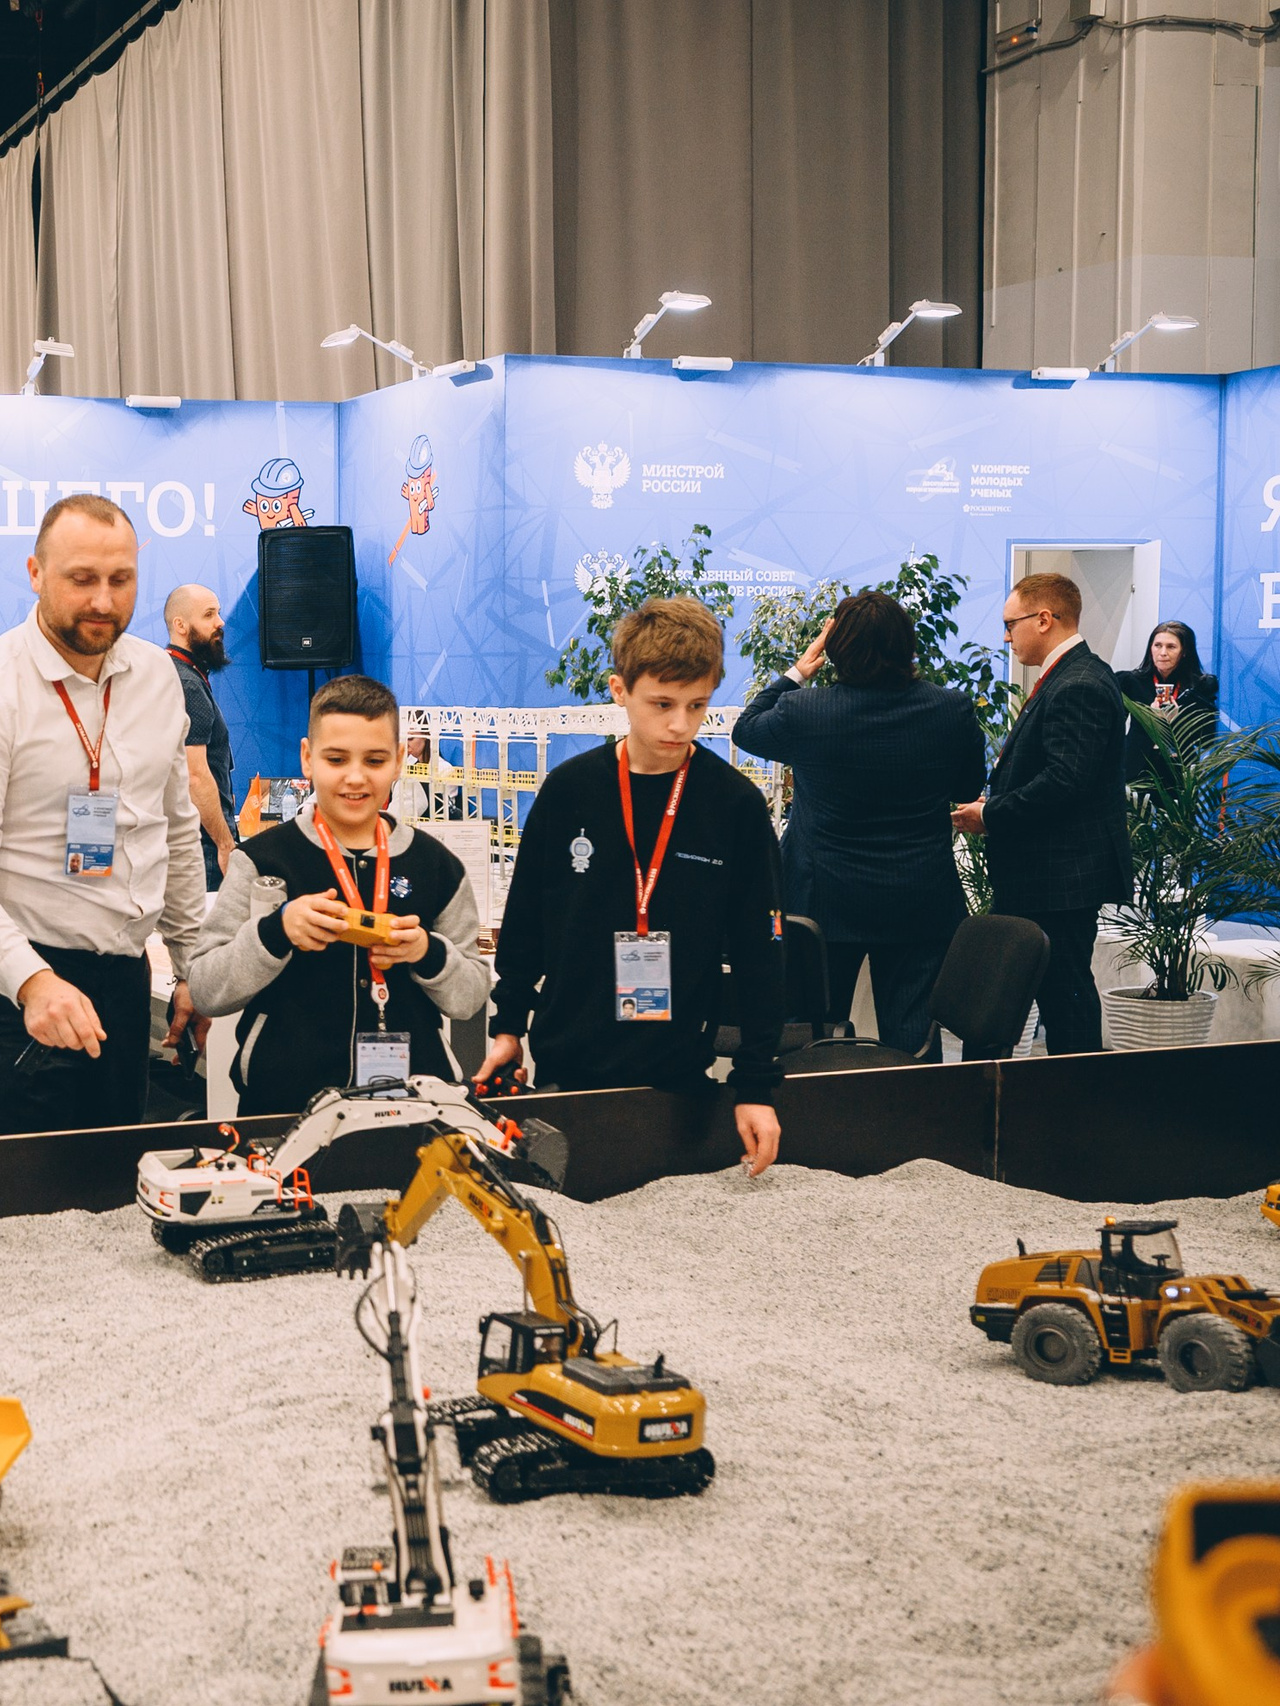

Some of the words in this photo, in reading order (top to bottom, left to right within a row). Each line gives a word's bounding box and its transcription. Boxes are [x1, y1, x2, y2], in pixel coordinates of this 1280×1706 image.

[642, 463, 725, 478] МИНСТРОЙ
[971, 465, 979, 474] V
[980, 465, 1030, 475] КОНГРЕСС
[642, 480, 702, 493] РОССИИ
[971, 477, 1023, 487] МОЛОДЫХ
[970, 488, 1012, 498] УЧЕНЫХ
[755, 570, 795, 582] СОВЕТ
[746, 586, 796, 597] РОССИИ
